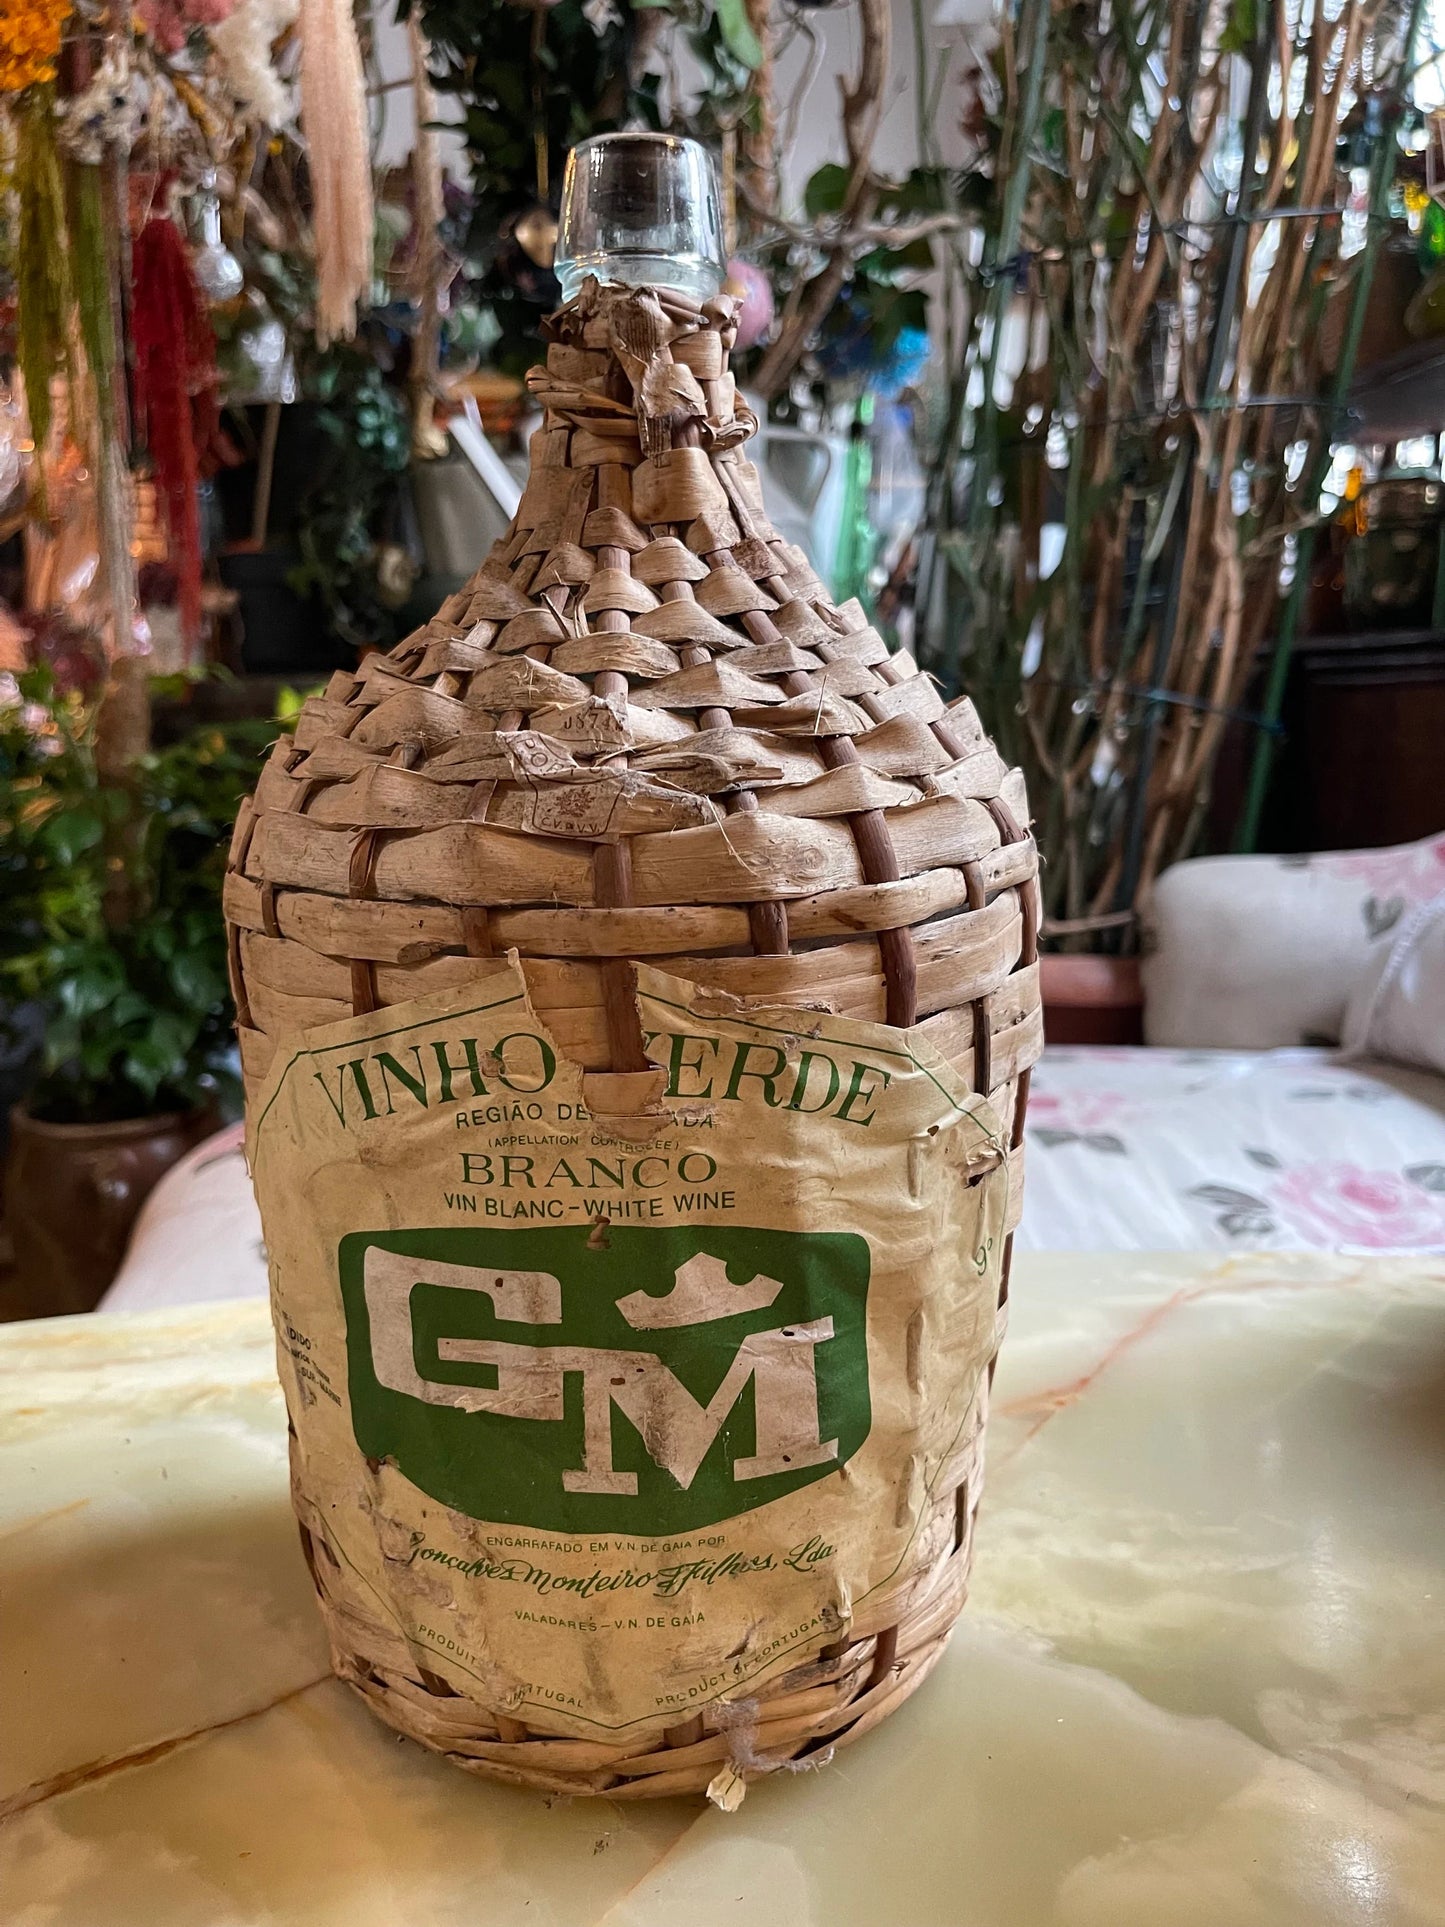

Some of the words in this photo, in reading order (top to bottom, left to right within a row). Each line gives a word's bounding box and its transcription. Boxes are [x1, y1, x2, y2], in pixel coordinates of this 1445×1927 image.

[313, 1032, 557, 1130] VINHO
[644, 1031, 892, 1127] ERDE
[456, 1101, 543, 1130] REGIÃO
[459, 1152, 718, 1190] BRANCO
[443, 1192, 477, 1214] VIN
[673, 1190, 736, 1213] WINE
[364, 1244, 839, 1496] GM
[486, 1536, 583, 1553] ENGARRAFADO
[589, 1542, 609, 1552] EM
[641, 1543, 658, 1553] DE
[661, 1540, 692, 1553] GAIA
[698, 1535, 726, 1547] POR
[500, 1559, 658, 1599] Monteiro
[646, 1617, 666, 1628] DE
[671, 1612, 706, 1628] GAIA
